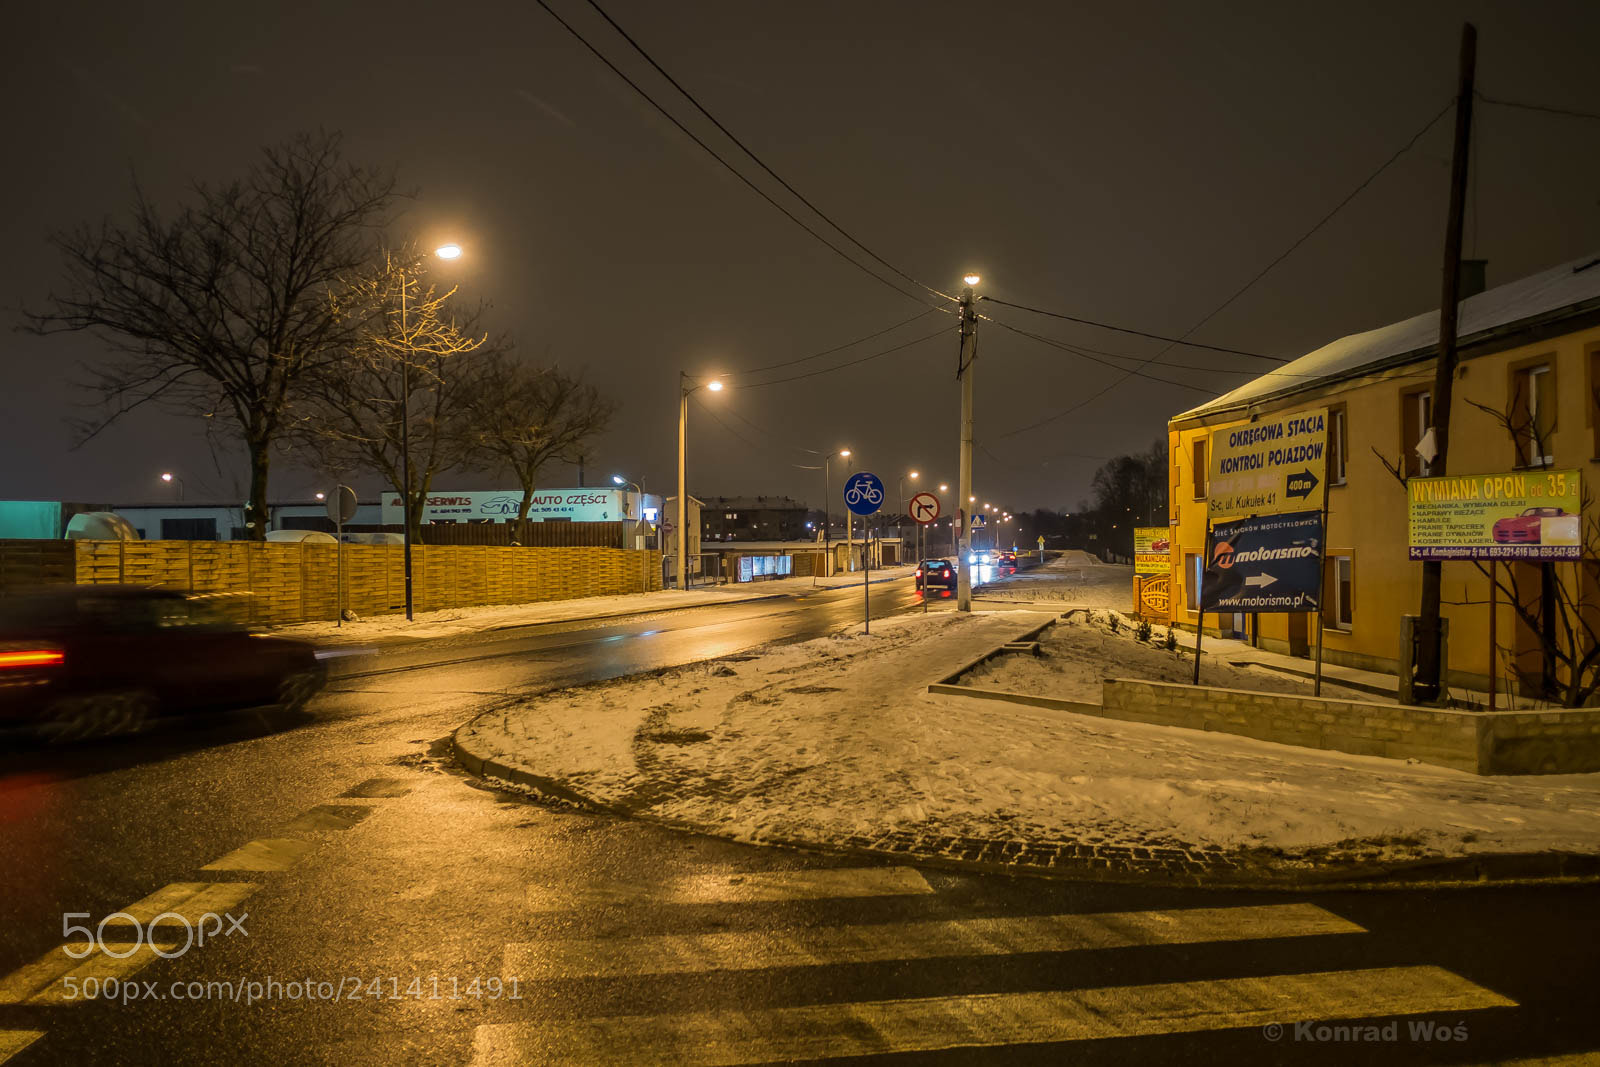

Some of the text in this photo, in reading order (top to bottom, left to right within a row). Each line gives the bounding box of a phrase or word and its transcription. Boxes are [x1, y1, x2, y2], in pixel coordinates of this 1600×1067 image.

[1230, 415, 1324, 448] OKRĘGOWA STACJA
[1220, 438, 1323, 474] KONTROLI POJAZDÓW
[1413, 479, 1479, 501] WYMIANA
[1484, 476, 1526, 499] OPON
[1531, 483, 1542, 497] od
[1547, 474, 1566, 497] 35
[425, 496, 472, 506] SERWIS
[531, 493, 607, 506] AUTO CZĘŚCI
[1225, 498, 1233, 510] ul.
[1236, 494, 1265, 509] Kukułek
[1267, 492, 1276, 505] 41
[1235, 546, 1313, 563] motorismo
[1219, 592, 1305, 608] www.motorismo.pl
